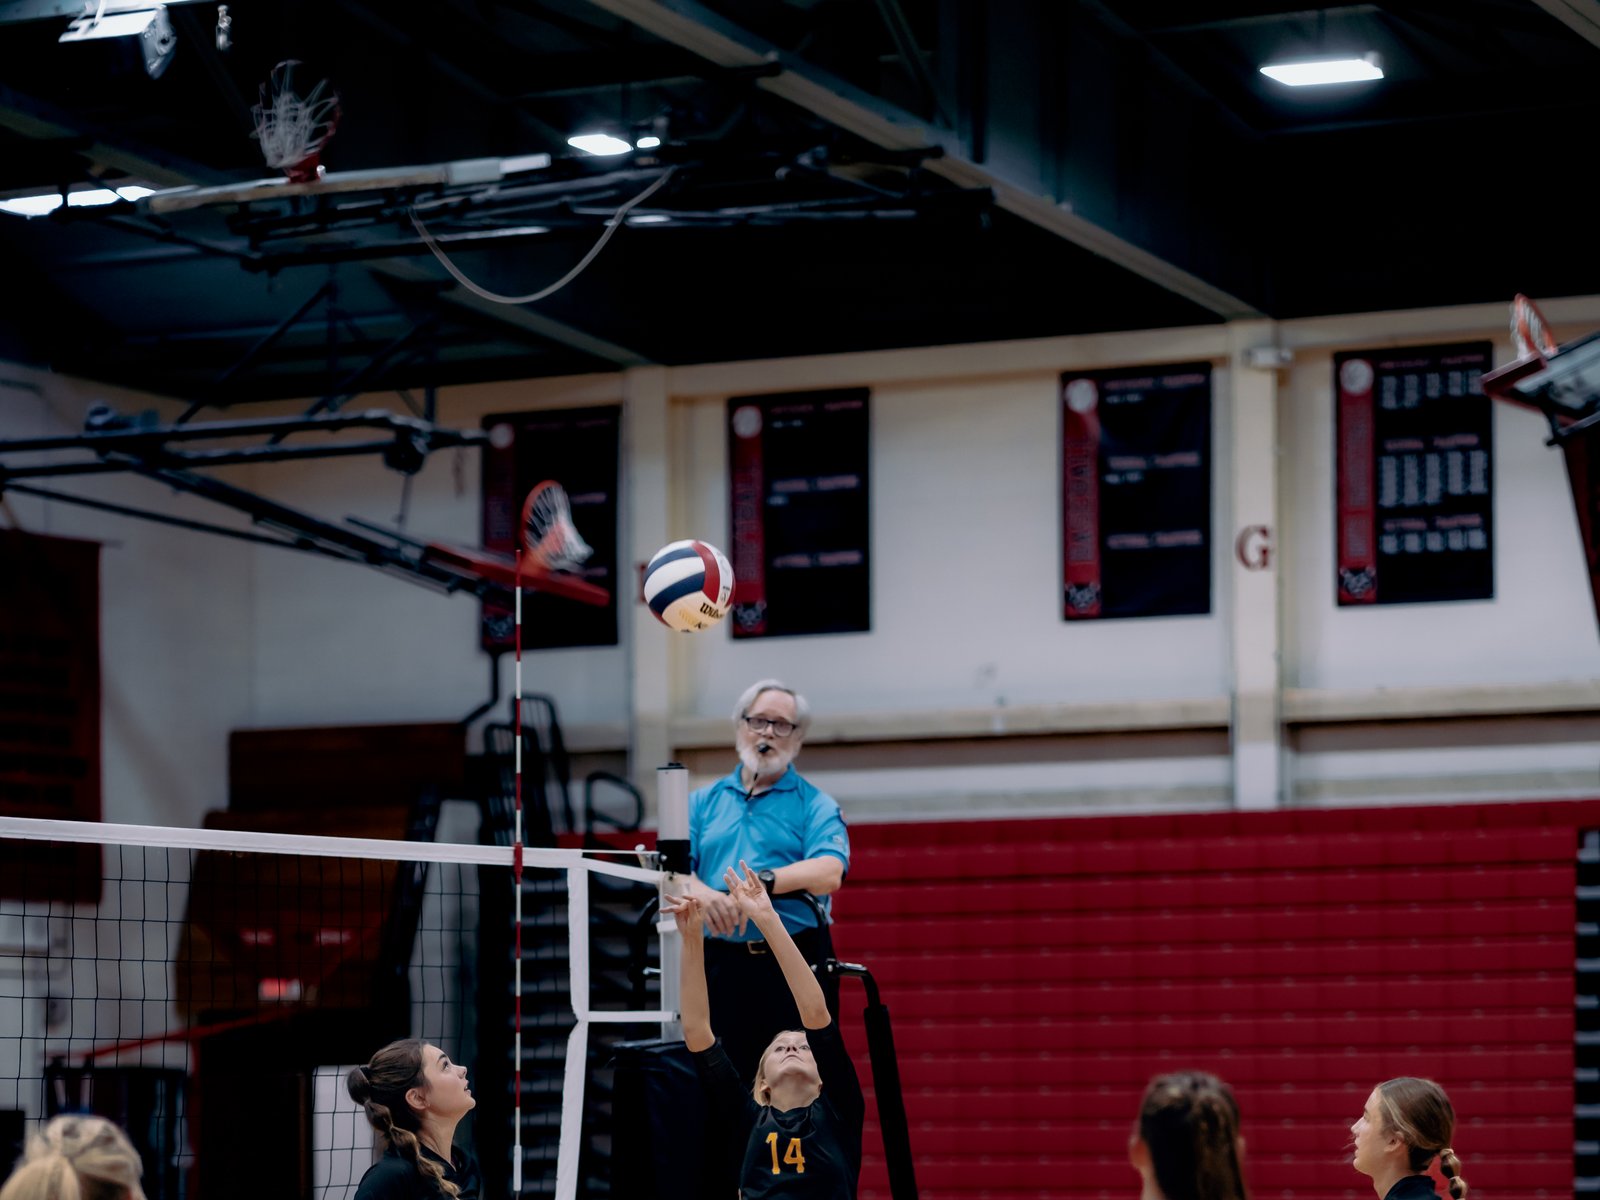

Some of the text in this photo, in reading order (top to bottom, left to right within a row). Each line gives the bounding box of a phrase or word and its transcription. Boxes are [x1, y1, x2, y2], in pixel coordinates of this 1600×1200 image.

[1235, 524, 1272, 571] G
[700, 602, 724, 618] Wils
[765, 1132, 806, 1175] 14
